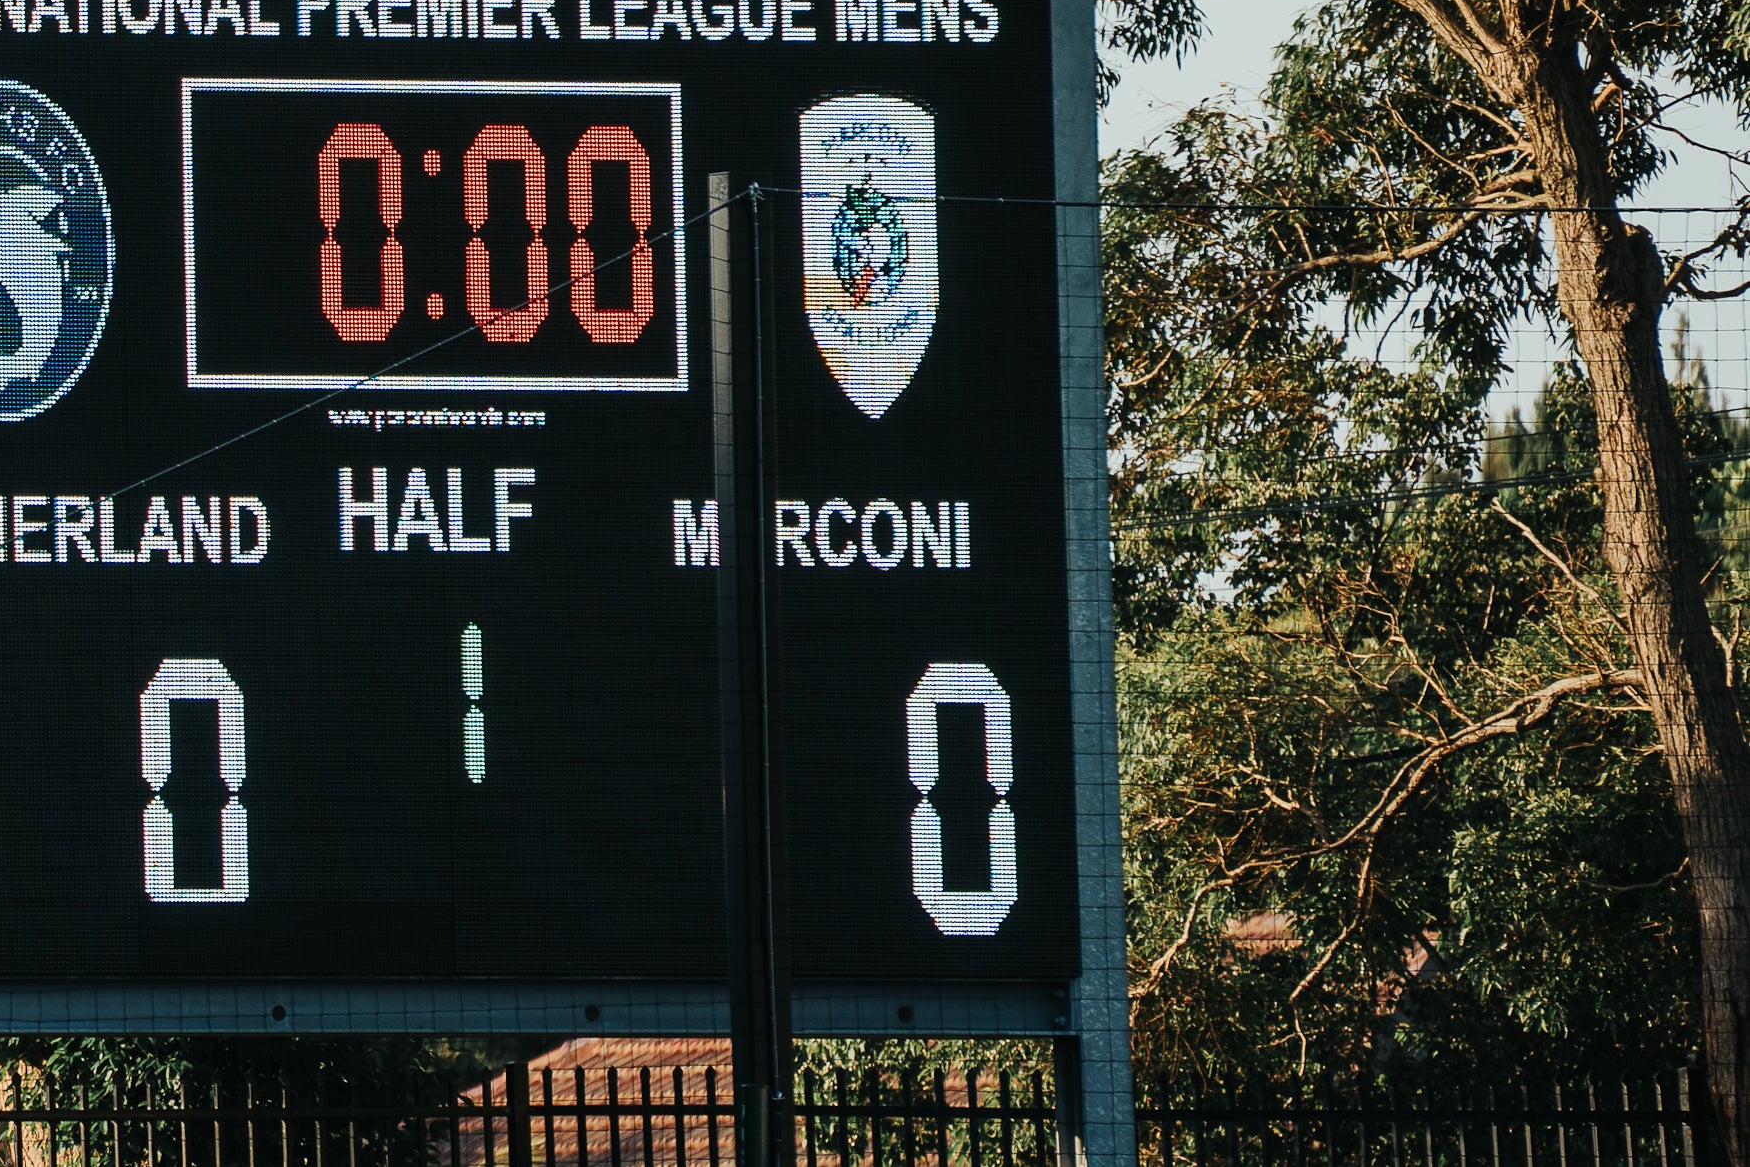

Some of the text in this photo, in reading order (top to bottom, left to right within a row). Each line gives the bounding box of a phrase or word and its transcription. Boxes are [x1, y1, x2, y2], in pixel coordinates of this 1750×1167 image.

[317, 123, 654, 343] 0:00
[339, 467, 536, 552] HALF
[673, 498, 970, 571] MRCONI
[140, 658, 249, 903] 0
[461, 621, 486, 784] 1
[906, 663, 1018, 936] 0
